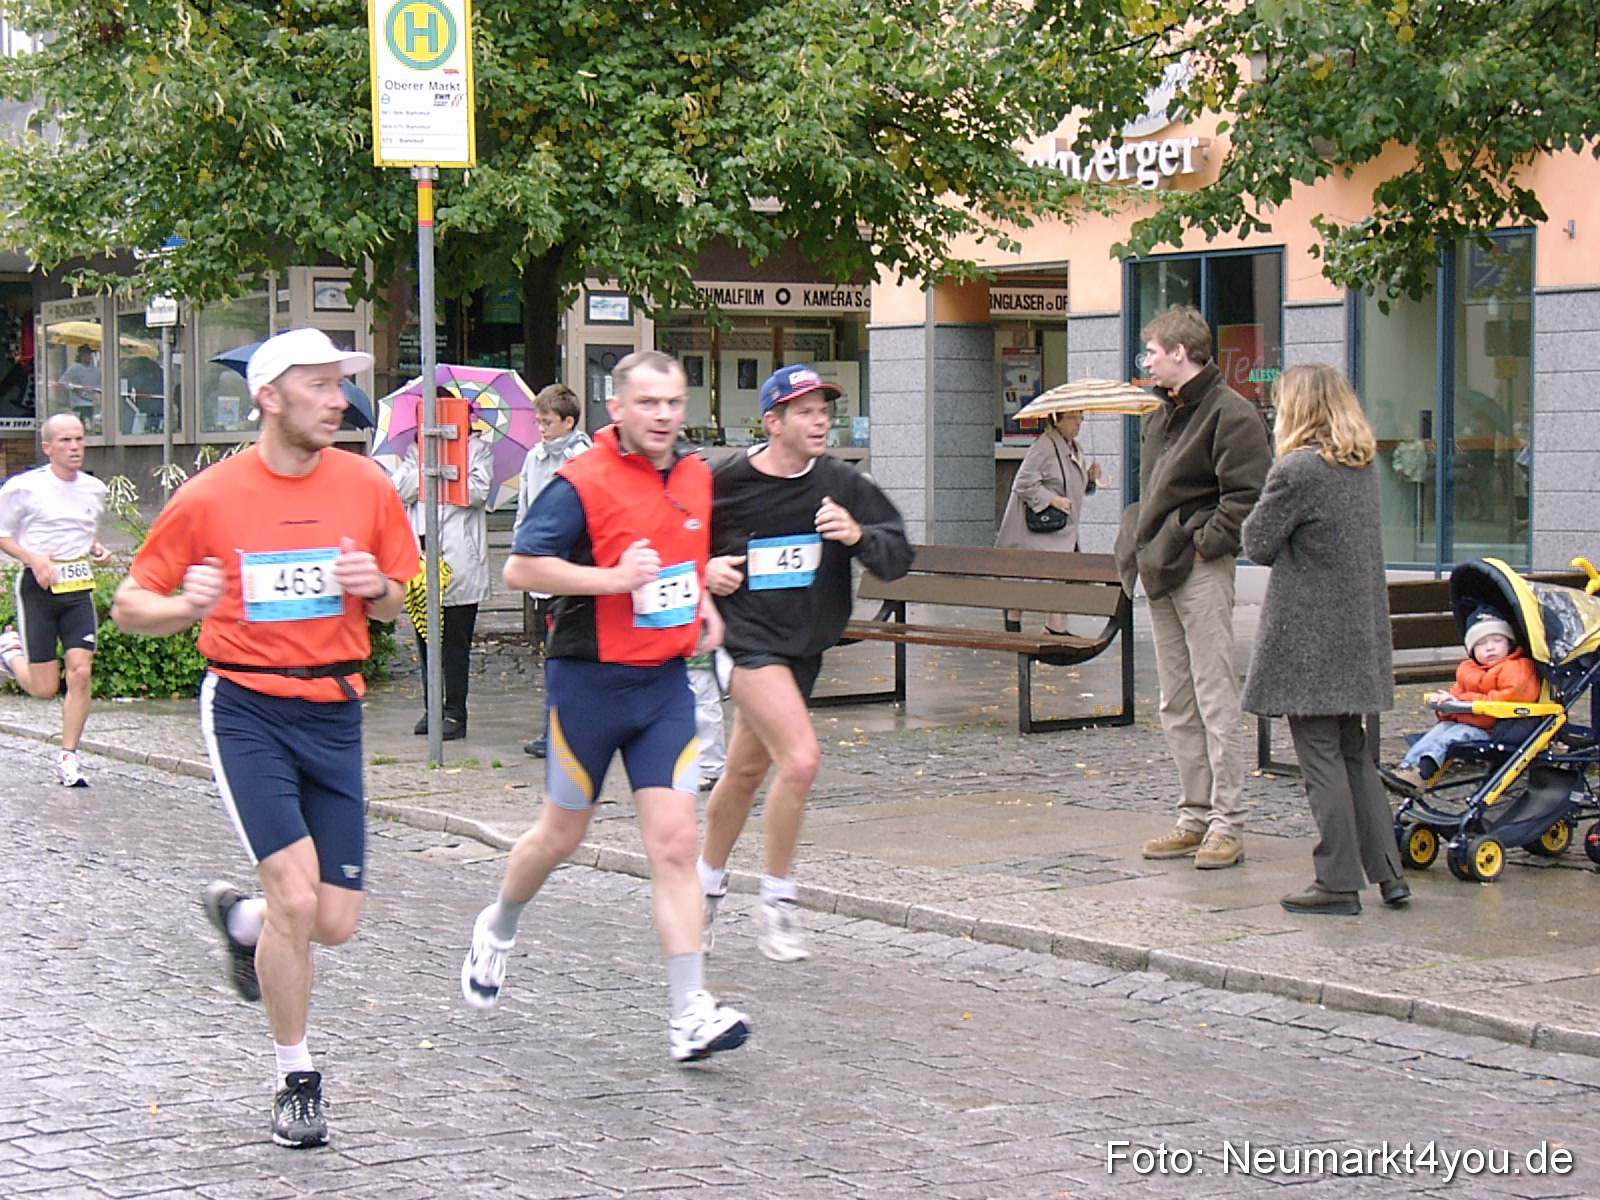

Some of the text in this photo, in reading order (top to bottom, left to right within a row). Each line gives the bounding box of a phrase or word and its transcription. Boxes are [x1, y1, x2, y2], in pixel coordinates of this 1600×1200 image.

[404, 12, 438, 52] H
[385, 80, 460, 91] Oberer Markt
[777, 548, 804, 570] 45
[273, 566, 325, 596] 463
